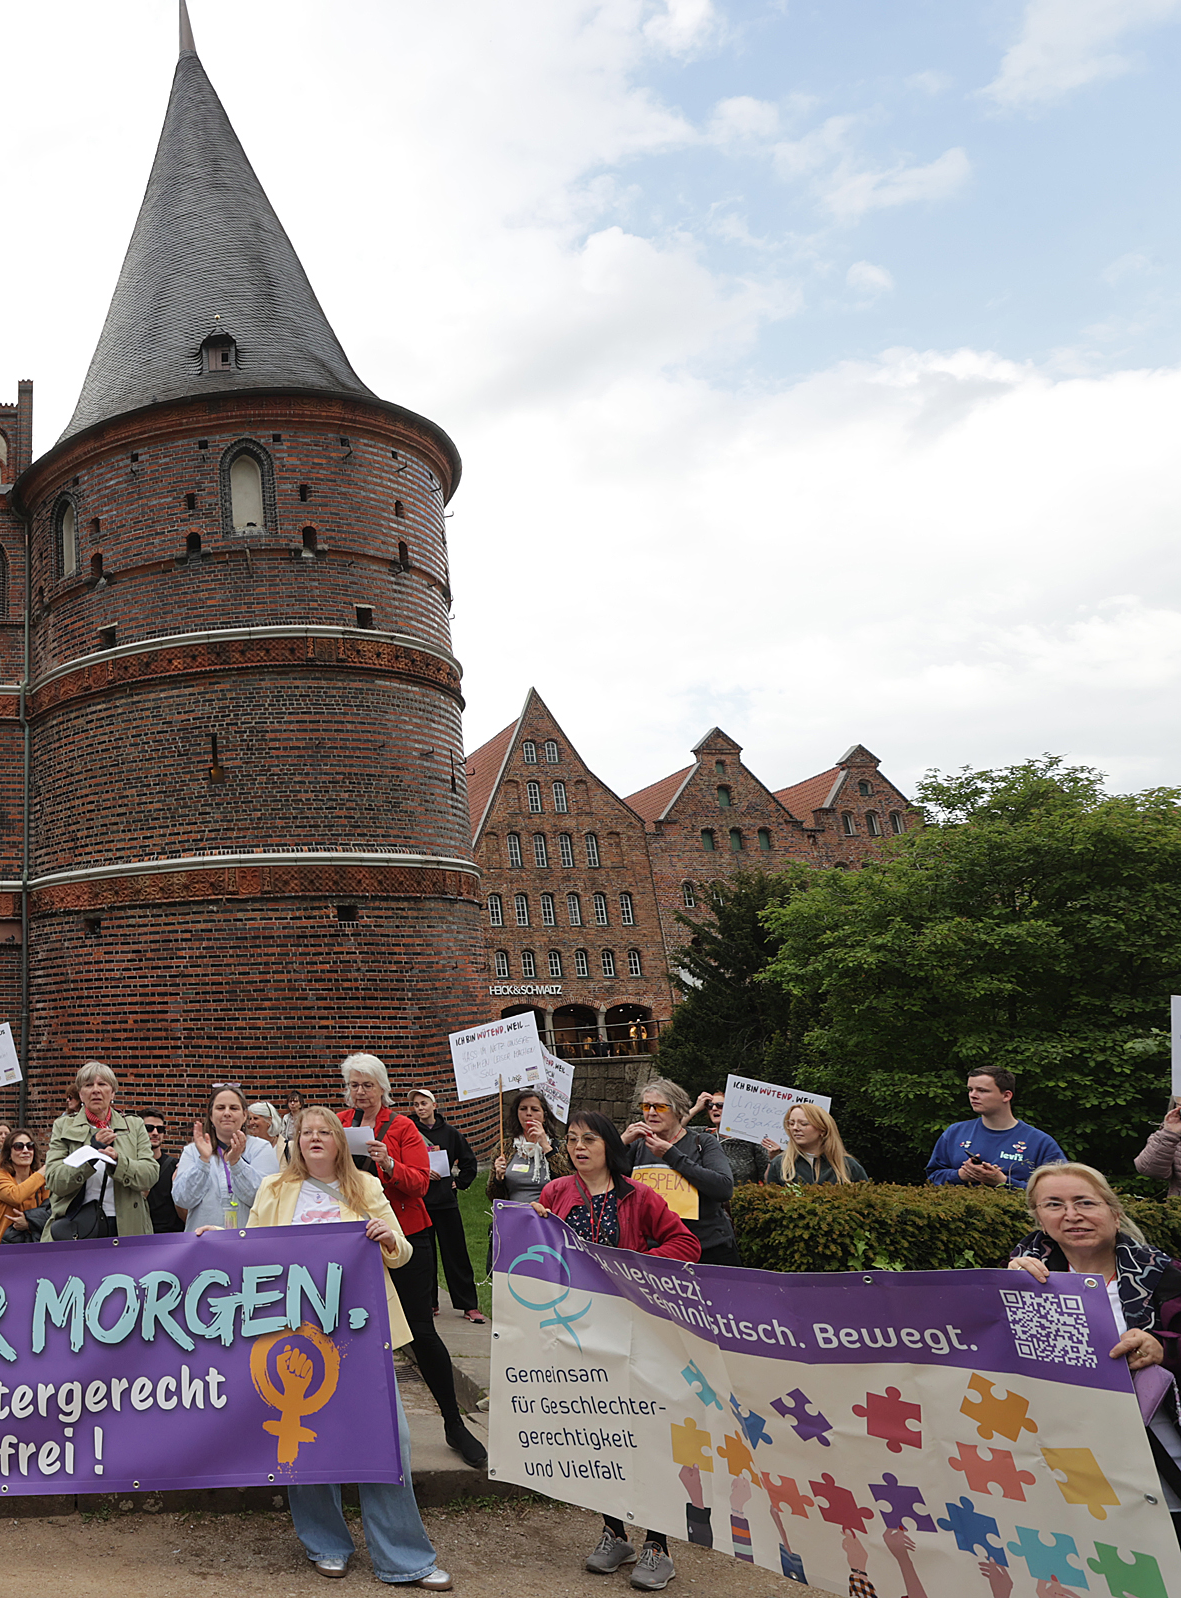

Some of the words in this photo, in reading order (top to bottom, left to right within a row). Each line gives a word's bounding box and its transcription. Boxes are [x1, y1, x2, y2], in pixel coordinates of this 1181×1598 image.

[455, 1036, 465, 1046] ICH
[466, 1033, 476, 1043] BIN
[507, 1021, 523, 1032] WEIL
[733, 1081, 745, 1089] ICH
[746, 1082, 759, 1093] BIN
[733, 1112, 785, 1129] Bezahlu
[614, 1261, 712, 1306] Vernetzt.
[31, 1262, 369, 1354] MORGEN.
[638, 1286, 806, 1348] Feministisch.
[812, 1323, 978, 1355] Bewegt.
[505, 1366, 609, 1383] Gemeinsam
[511, 1396, 536, 1414] für
[540, 1396, 667, 1415] Geschlechter-
[518, 1428, 638, 1450] gerechtigkeit
[524, 1459, 554, 1478] und
[558, 1460, 626, 1481] Vielfalt
